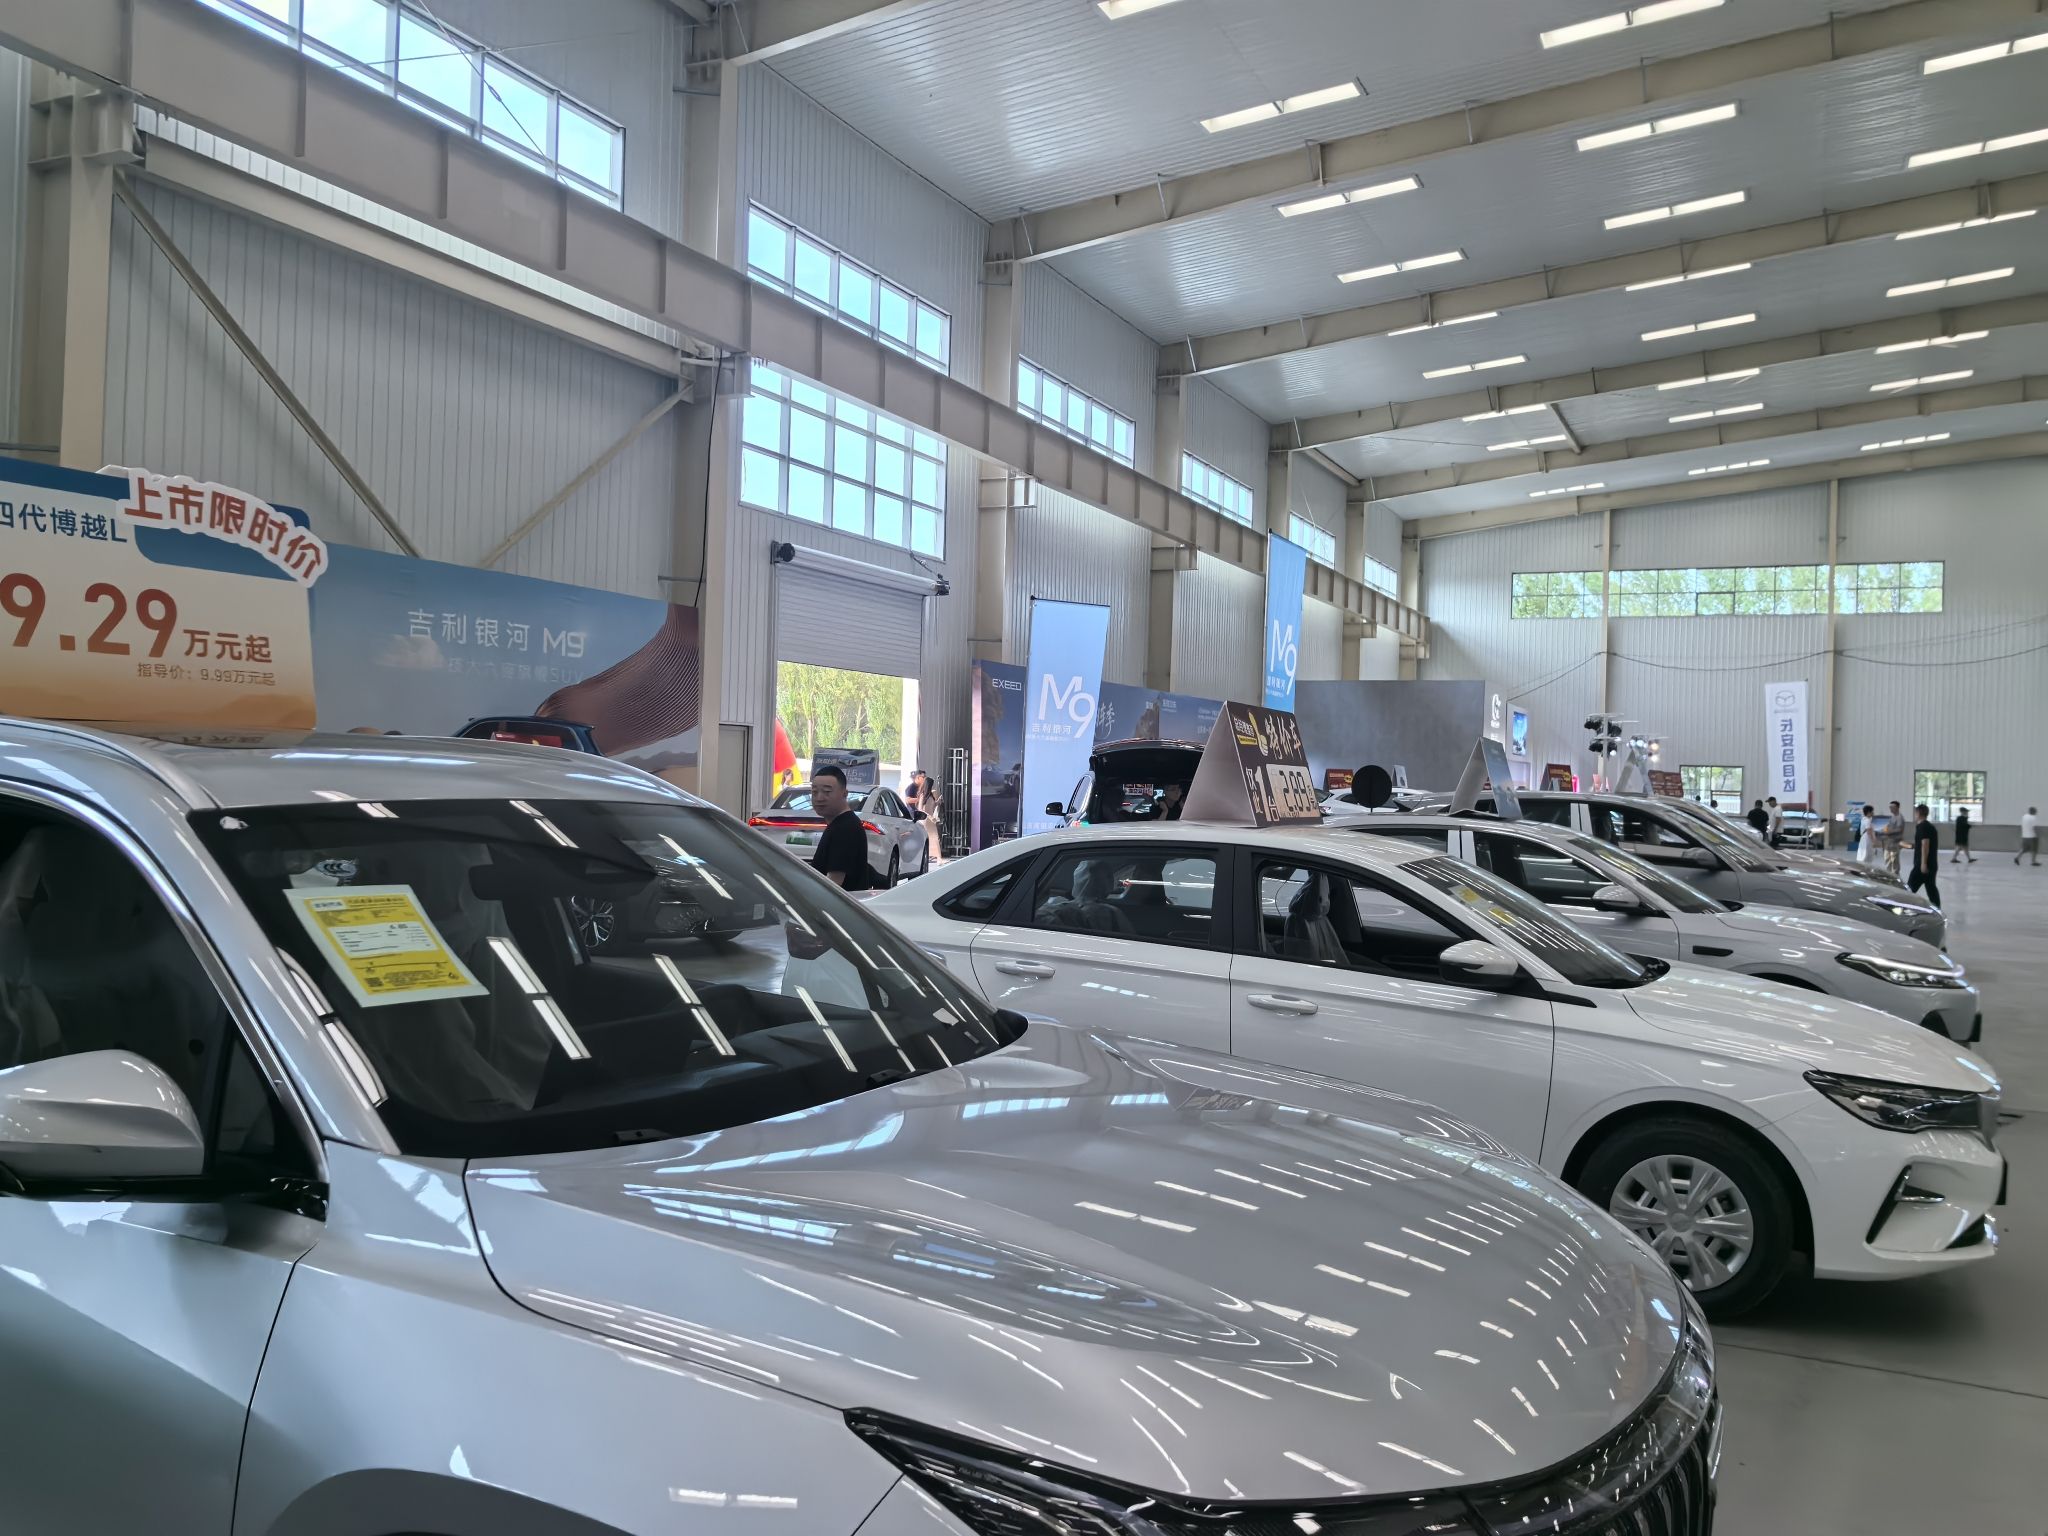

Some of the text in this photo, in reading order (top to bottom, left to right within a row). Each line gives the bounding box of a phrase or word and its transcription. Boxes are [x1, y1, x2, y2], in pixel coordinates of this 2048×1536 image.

[124, 477, 322, 579] 上市限时价
[408, 608, 585, 657] 吉利银河 M9
[1270, 619, 1297, 695] M9
[992, 678, 1022, 691] EXEED
[1038, 673, 1096, 739] M9
